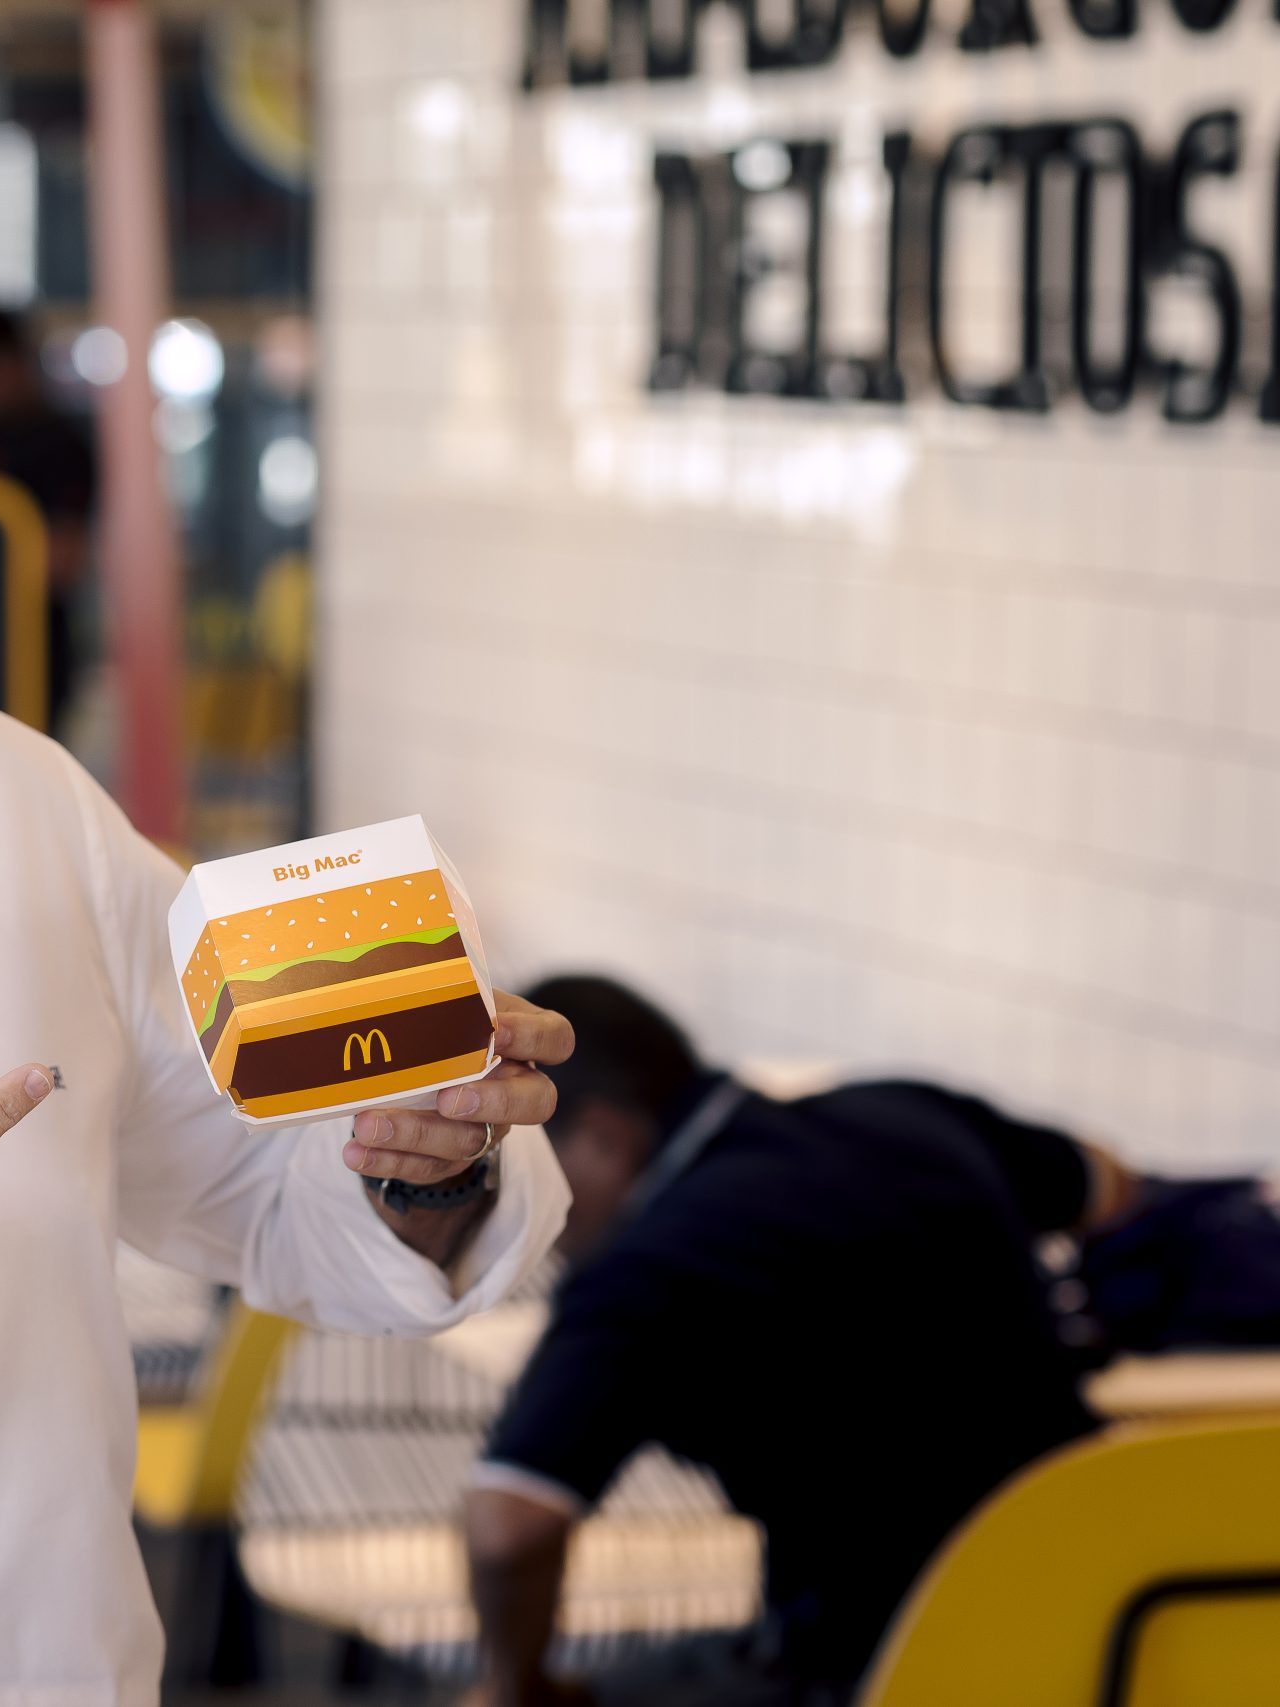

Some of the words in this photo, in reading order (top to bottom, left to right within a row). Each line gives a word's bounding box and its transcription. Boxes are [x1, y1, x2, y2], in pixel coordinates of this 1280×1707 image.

[649, 110, 1280, 424] DELICIOS
[272, 863, 311, 882] Big
[314, 852, 362, 873] Mac
